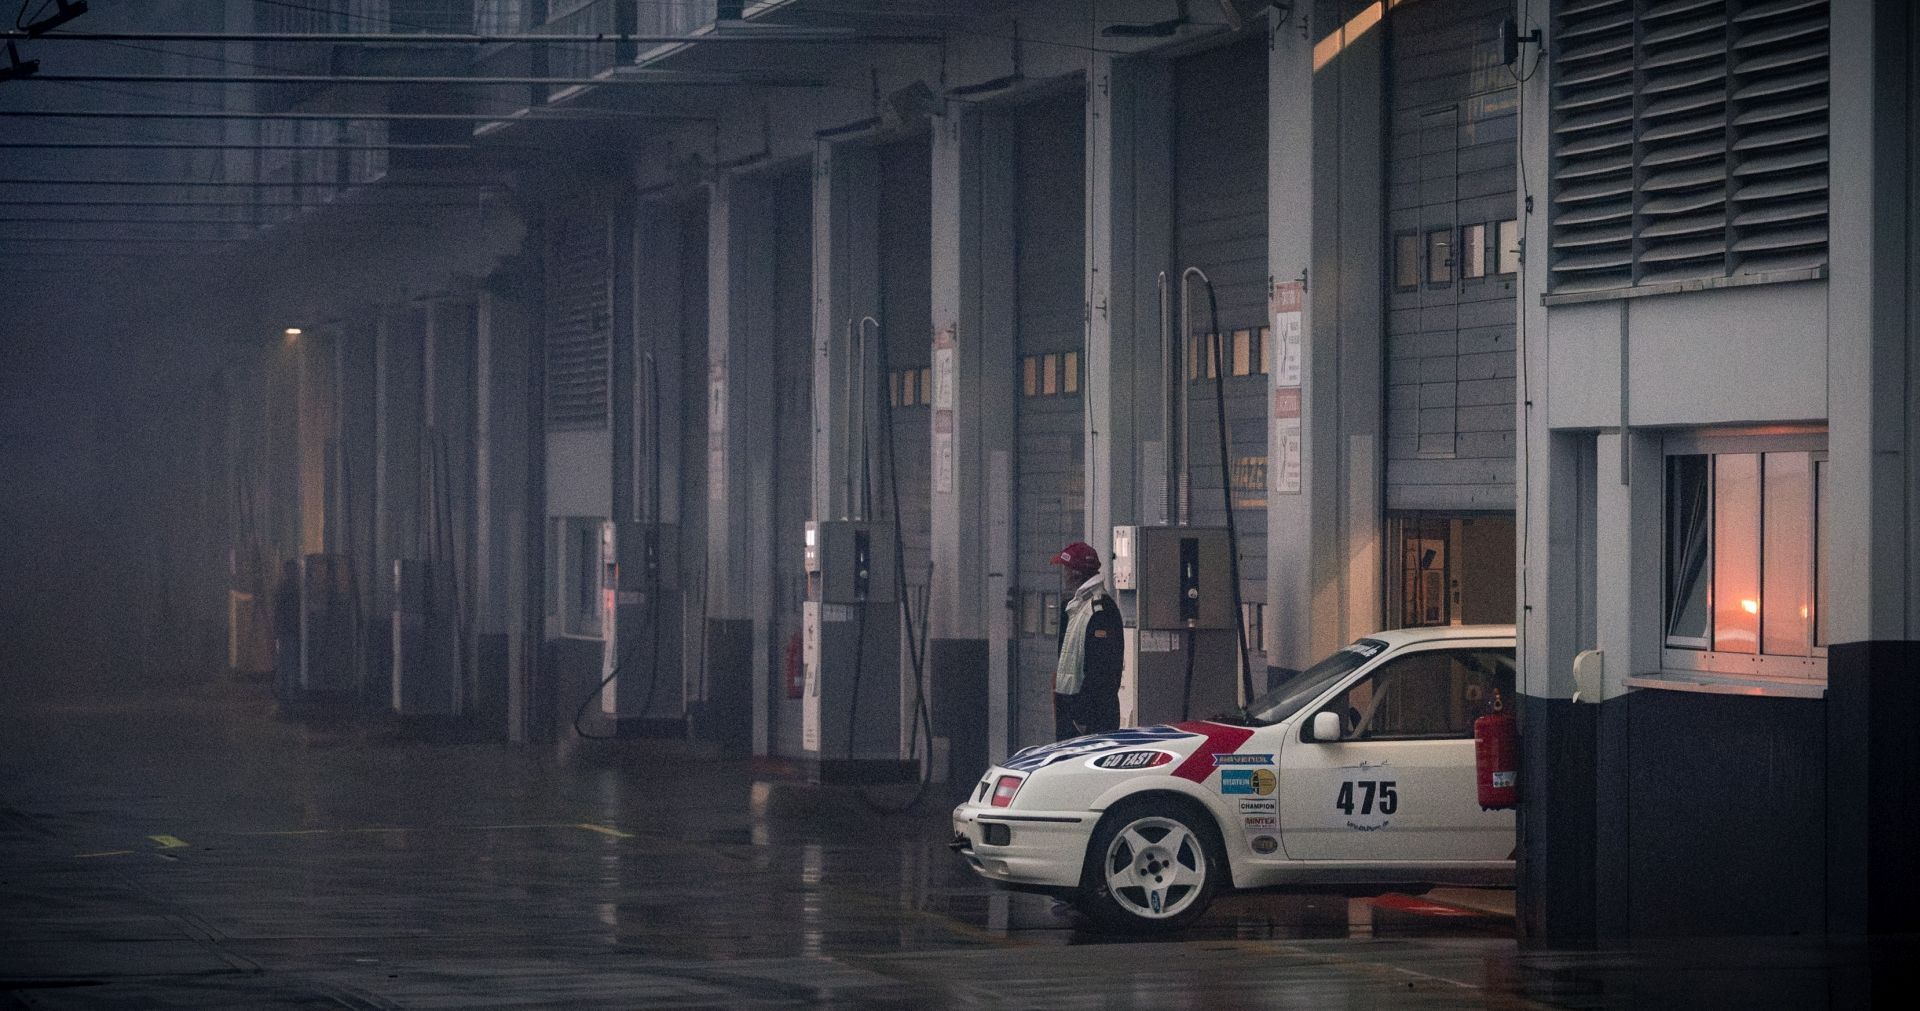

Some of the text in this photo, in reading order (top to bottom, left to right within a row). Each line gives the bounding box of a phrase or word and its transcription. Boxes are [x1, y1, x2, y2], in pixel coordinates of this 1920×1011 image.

[1101, 754, 1124, 767] GO
[1121, 752, 1156, 766] FAST
[1336, 781, 1398, 815] 475
[1245, 817, 1275, 825] MINTEX
